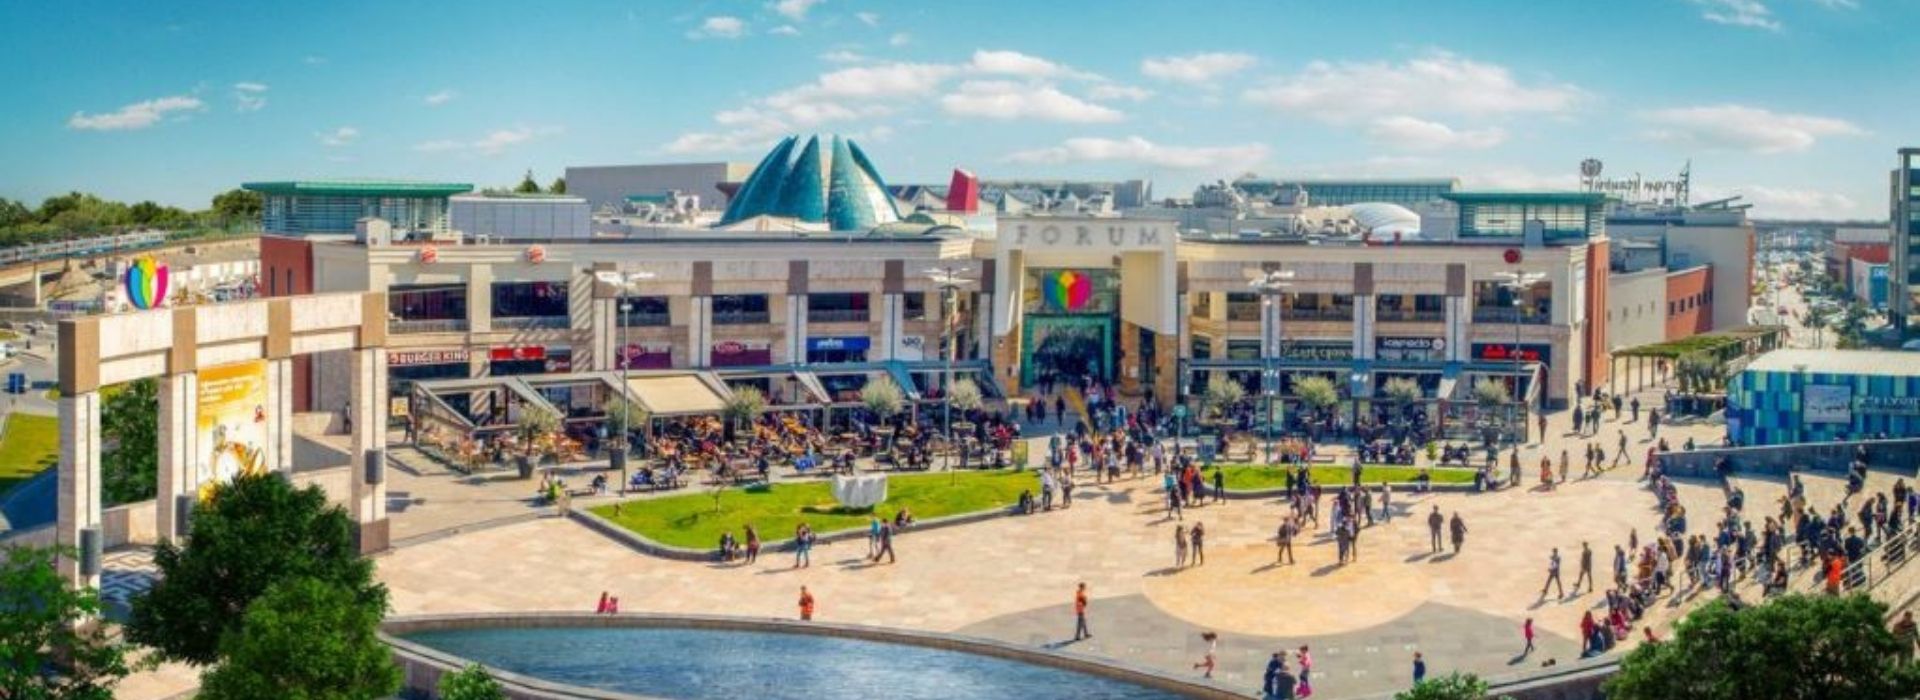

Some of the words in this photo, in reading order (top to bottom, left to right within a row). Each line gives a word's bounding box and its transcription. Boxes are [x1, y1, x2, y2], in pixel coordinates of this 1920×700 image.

[1015, 225, 1161, 246] FORUM
[400, 351, 442, 363] BURGER
[443, 350, 469, 361] KING
